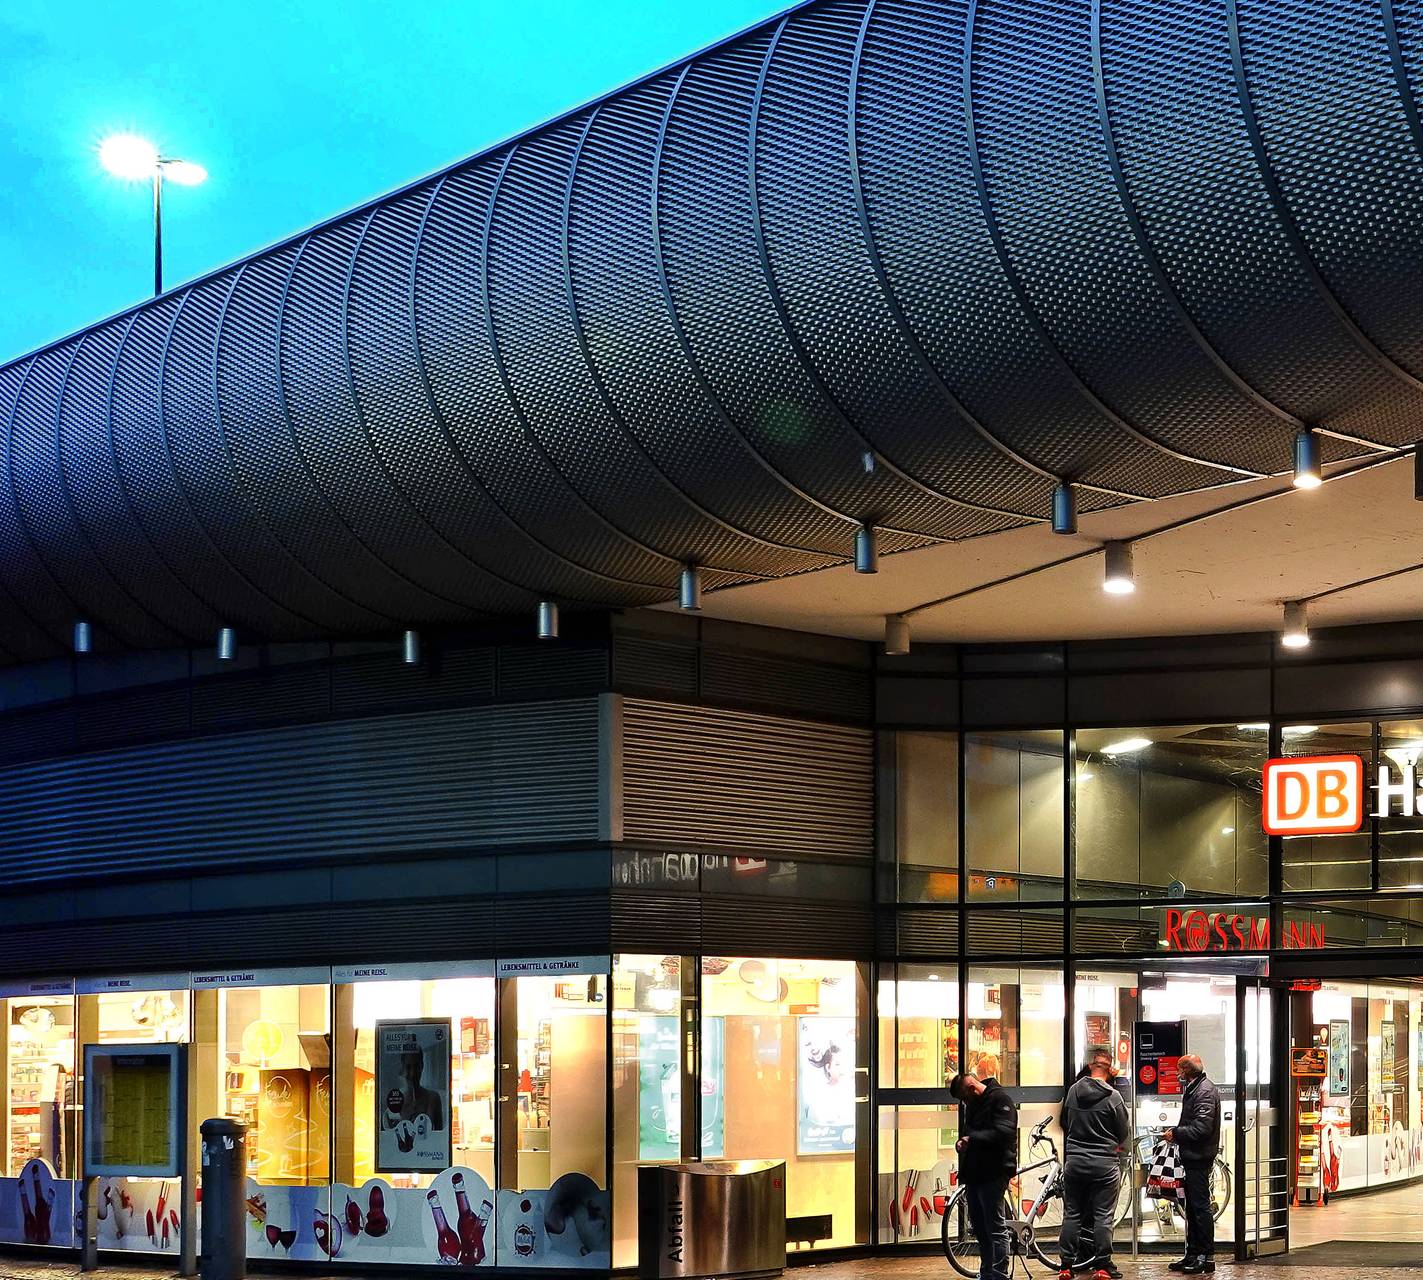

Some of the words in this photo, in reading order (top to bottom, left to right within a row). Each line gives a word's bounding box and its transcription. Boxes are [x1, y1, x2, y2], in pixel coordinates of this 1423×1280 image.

[1276, 769, 1349, 820] DB
[501, 962, 542, 971] LEBENSMITTEL
[543, 962, 548, 970] &
[549, 960, 579, 969] GETRÄNKE
[667, 1200, 684, 1264] Abfall
